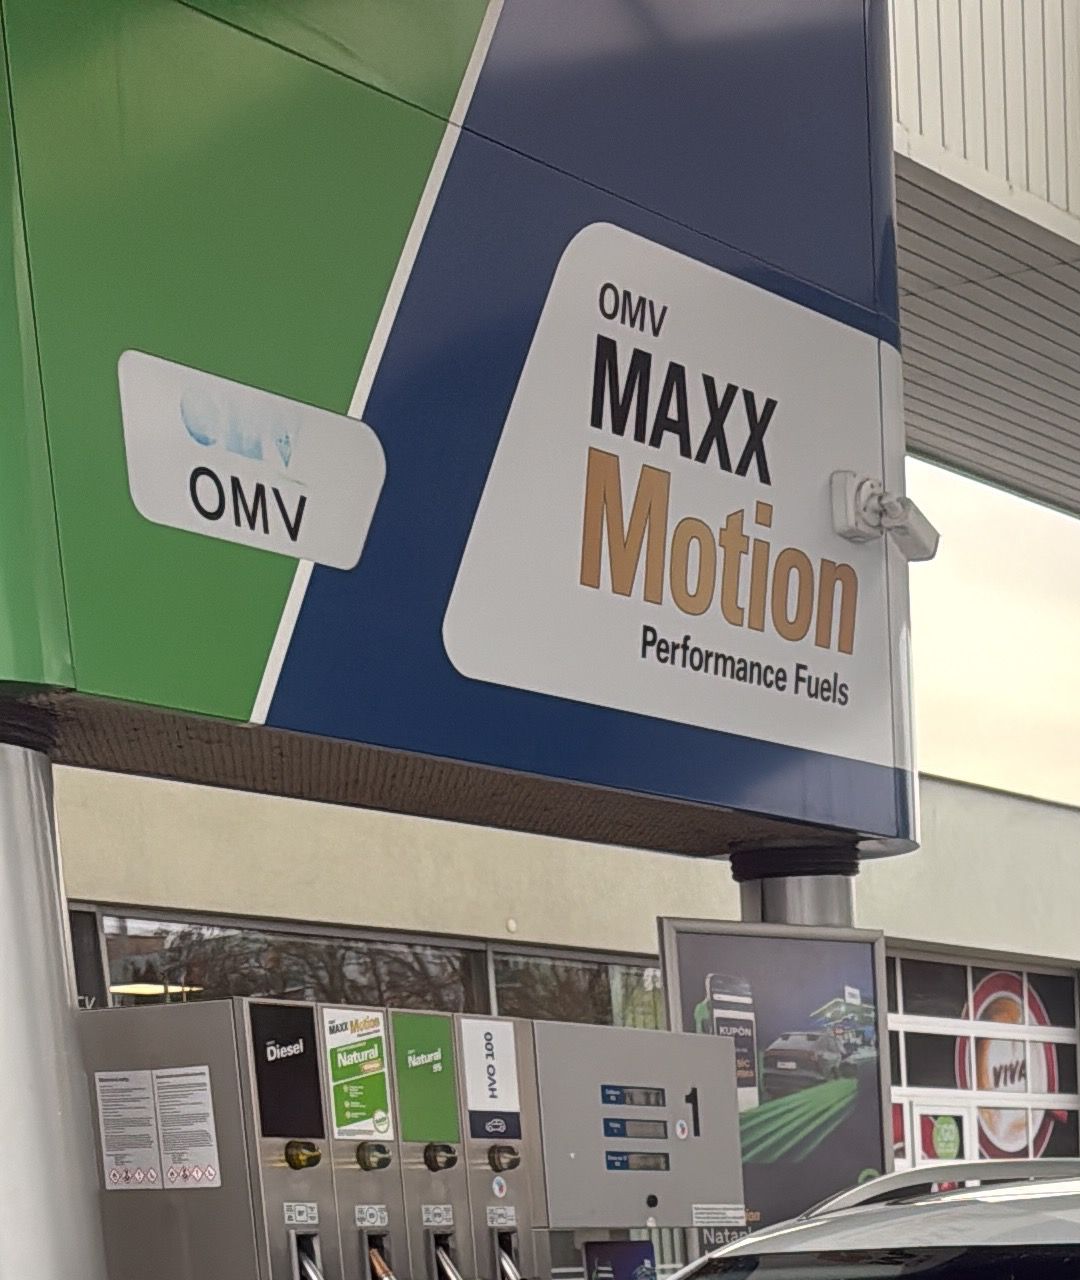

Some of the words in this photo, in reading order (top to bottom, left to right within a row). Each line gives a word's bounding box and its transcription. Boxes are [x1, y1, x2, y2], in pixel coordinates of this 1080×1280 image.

[599, 282, 668, 337] OMV
[590, 334, 778, 486] MAXX
[190, 466, 306, 542] OMV
[580, 446, 859, 656] Motion
[641, 625, 787, 692] Performance
[794, 663, 849, 706] Fuels
[328, 1022, 348, 1035] MAXX
[349, 1016, 380, 1034] Motion
[266, 1038, 304, 1061] Diesel
[337, 1044, 379, 1068] Natural
[407, 1048, 442, 1068] Natural
[484, 1031, 495, 1060] 100
[487, 1064, 498, 1099] HVO
[992, 1059, 1027, 1088] VIVA
[685, 1087, 700, 1137] 1
